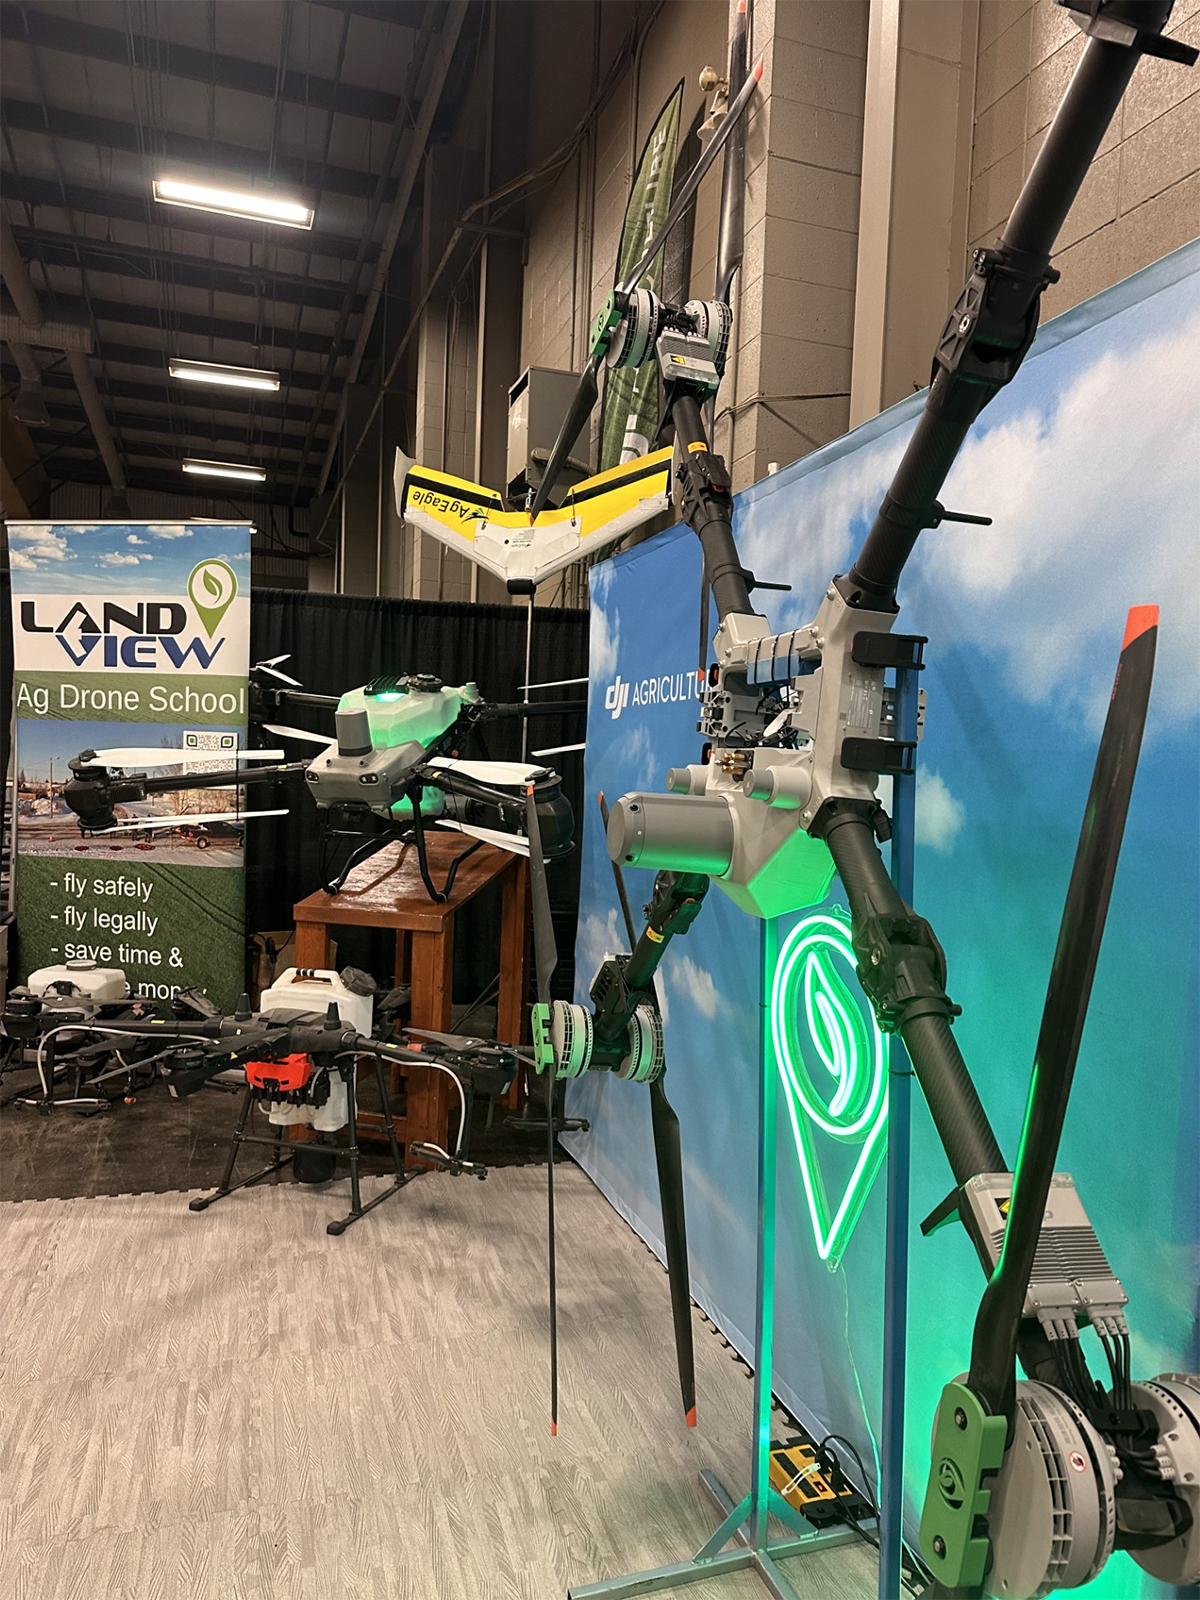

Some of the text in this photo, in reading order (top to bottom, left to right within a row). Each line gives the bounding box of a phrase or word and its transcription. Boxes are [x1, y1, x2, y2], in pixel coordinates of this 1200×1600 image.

[413, 491, 470, 518] AgEagle
[20, 601, 187, 635] LAND
[55, 635, 226, 669] VIEW
[17, 683, 245, 714] Ag Drone School
[64, 873, 87, 898] fly
[93, 876, 153, 903] safely
[64, 906, 87, 931] fly
[94, 908, 158, 936] legally
[64, 942, 112, 962] save
[118, 943, 162, 966] time
[168, 947, 183, 968] &
[138, 982, 207, 1001] mon
